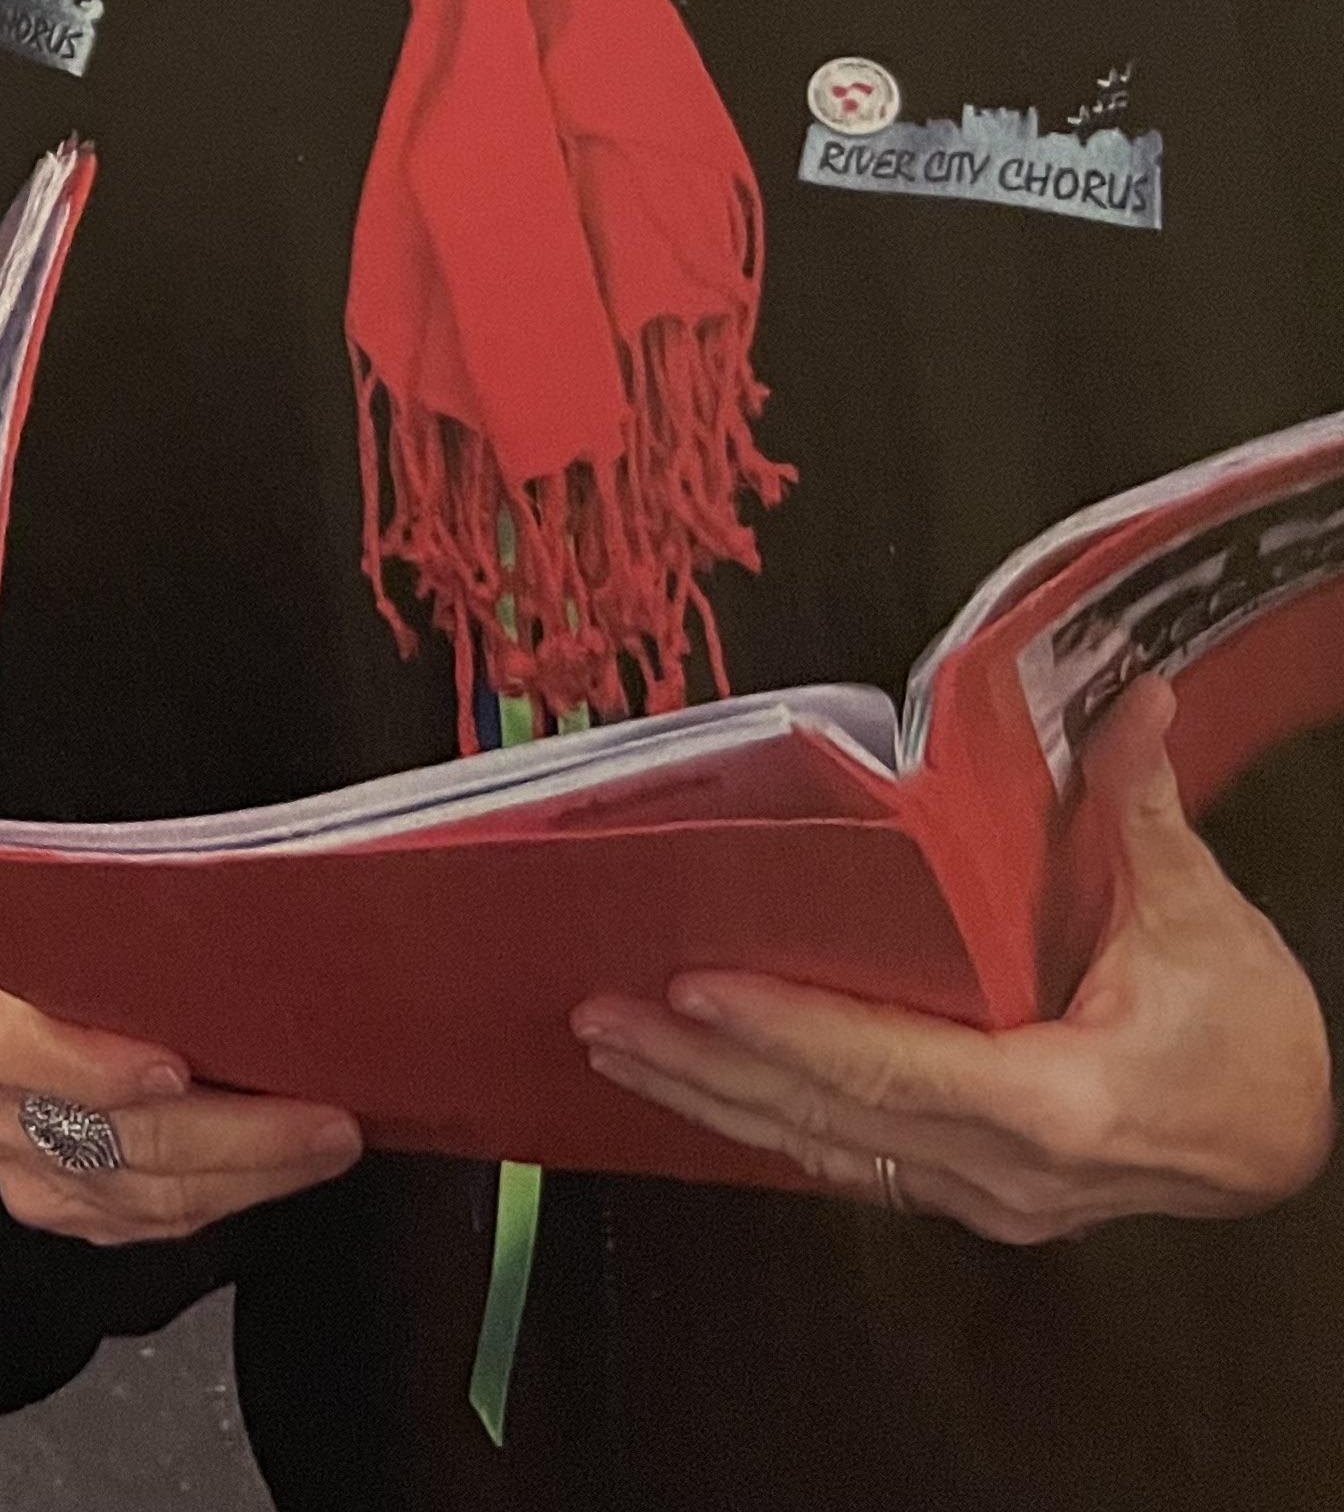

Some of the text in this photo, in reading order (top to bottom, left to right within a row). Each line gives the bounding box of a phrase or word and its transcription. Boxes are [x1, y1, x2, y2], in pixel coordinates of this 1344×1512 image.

[819, 140, 1148, 213] RIVER CITY CHORUS
